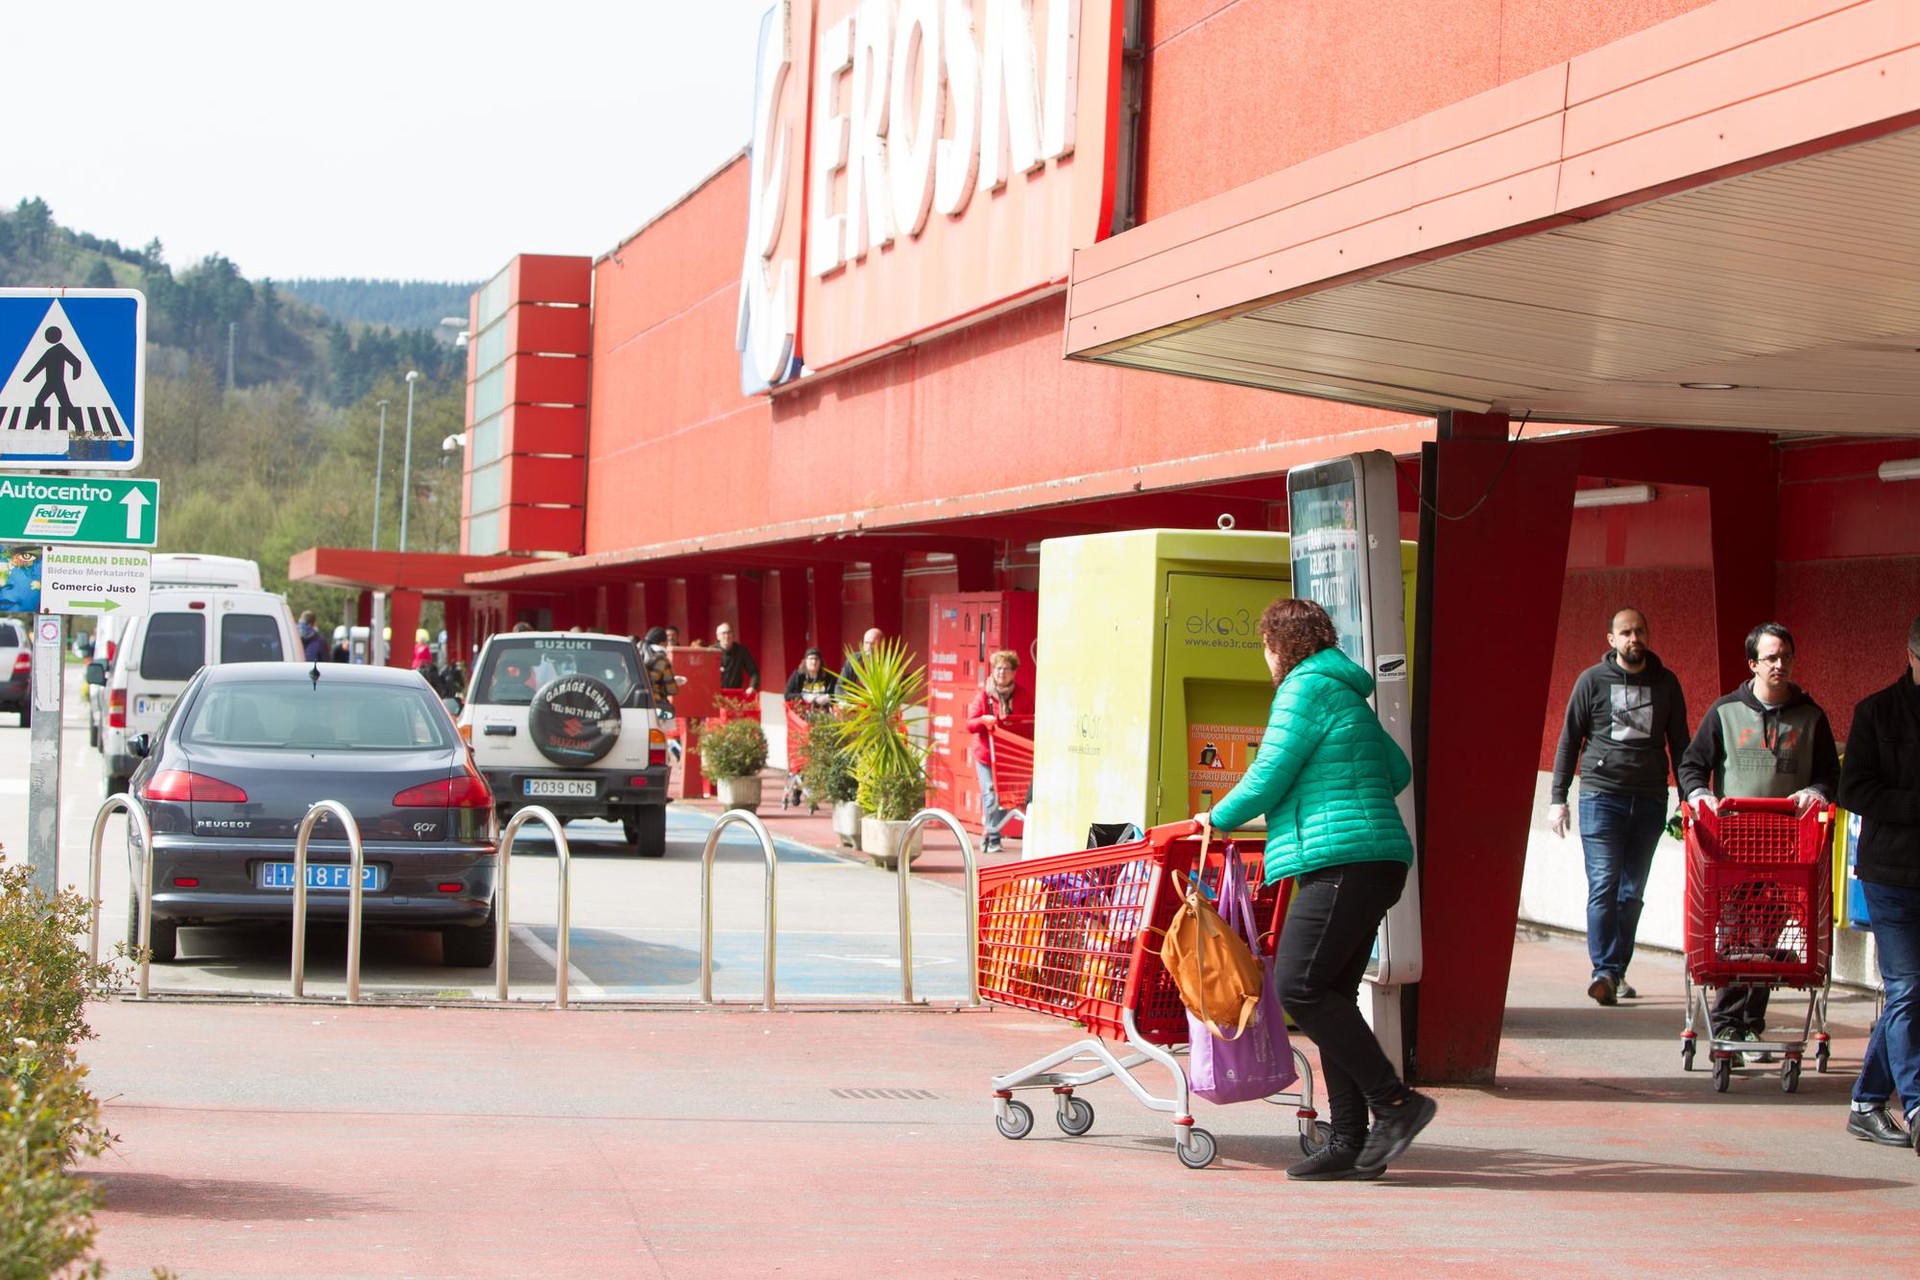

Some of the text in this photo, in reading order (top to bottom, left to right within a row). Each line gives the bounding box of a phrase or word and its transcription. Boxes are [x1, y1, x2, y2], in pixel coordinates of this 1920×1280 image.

[0, 480, 112, 502] Autocentro
[47, 554, 148, 566] HARREMAN DENDA
[48, 567, 144, 578] Bidezko Merkataritza
[52, 582, 136, 593] Comercio Justo
[534, 639, 592, 650] SUZUKI
[1185, 638, 1262, 649] www.eko3r.com
[545, 681, 586, 703] GARAGE
[549, 736, 592, 750] SUZUKI
[533, 781, 592, 794] 2039 CNS
[197, 820, 251, 829] PEUGEOT
[413, 822, 437, 832] 607
[280, 866, 328, 886] 118
